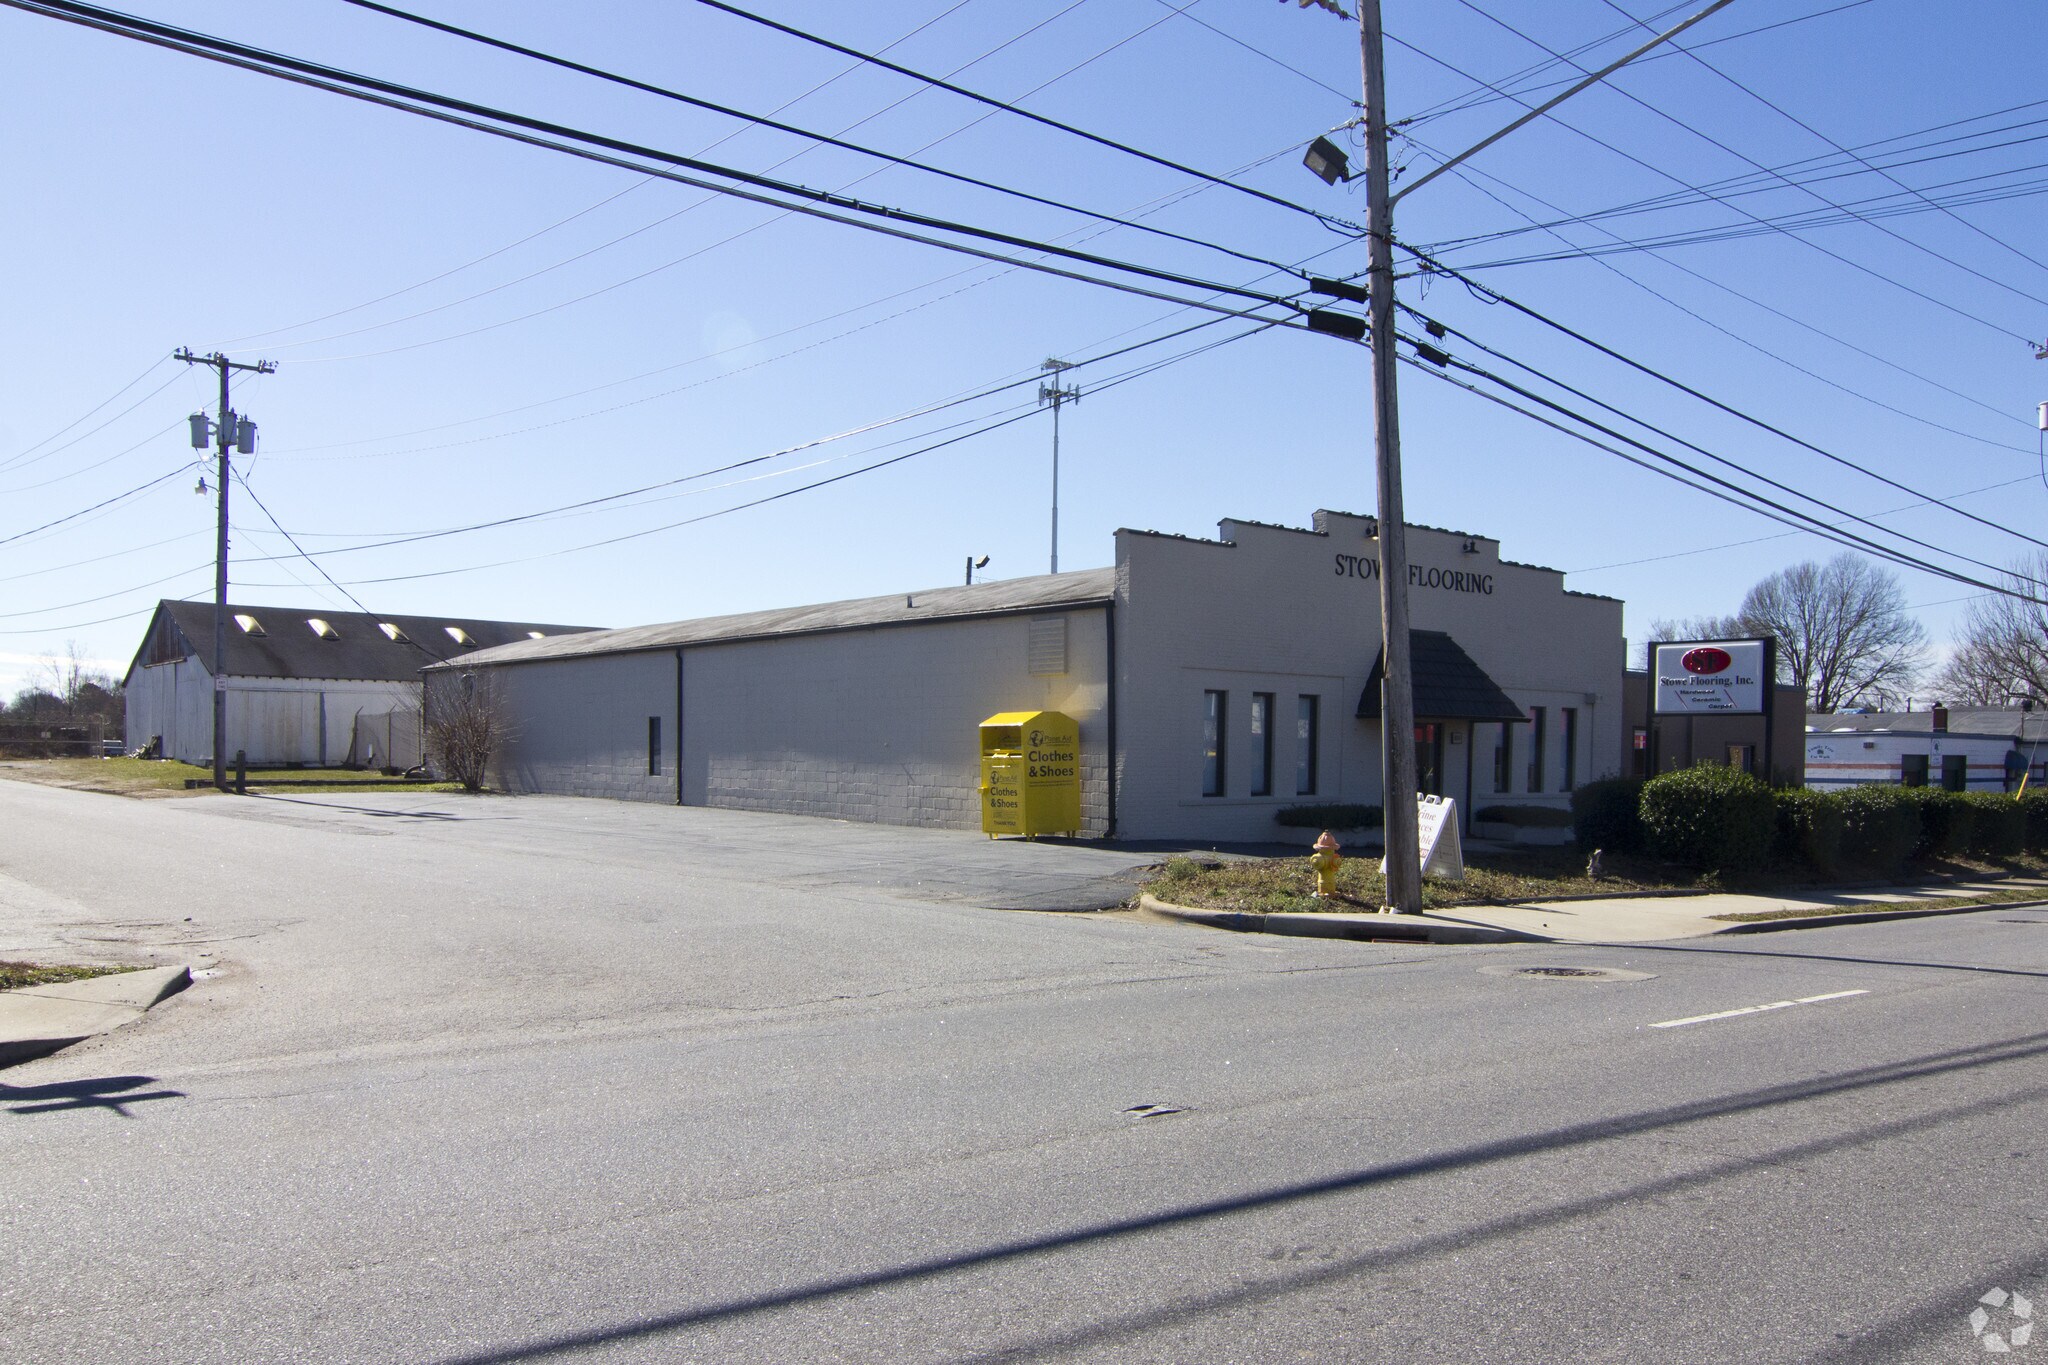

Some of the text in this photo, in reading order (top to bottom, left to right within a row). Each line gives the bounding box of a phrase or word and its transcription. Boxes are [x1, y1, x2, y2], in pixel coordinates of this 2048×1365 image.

[1408, 565, 1493, 595] FLOORING
[1660, 675, 1754, 687] Stowe Flooring, Inc.
[1028, 750, 1074, 762] Clothes
[1028, 765, 1074, 777] & Shoes
[990, 787, 1018, 797] Clothes
[991, 798, 1018, 808] & Shoes
